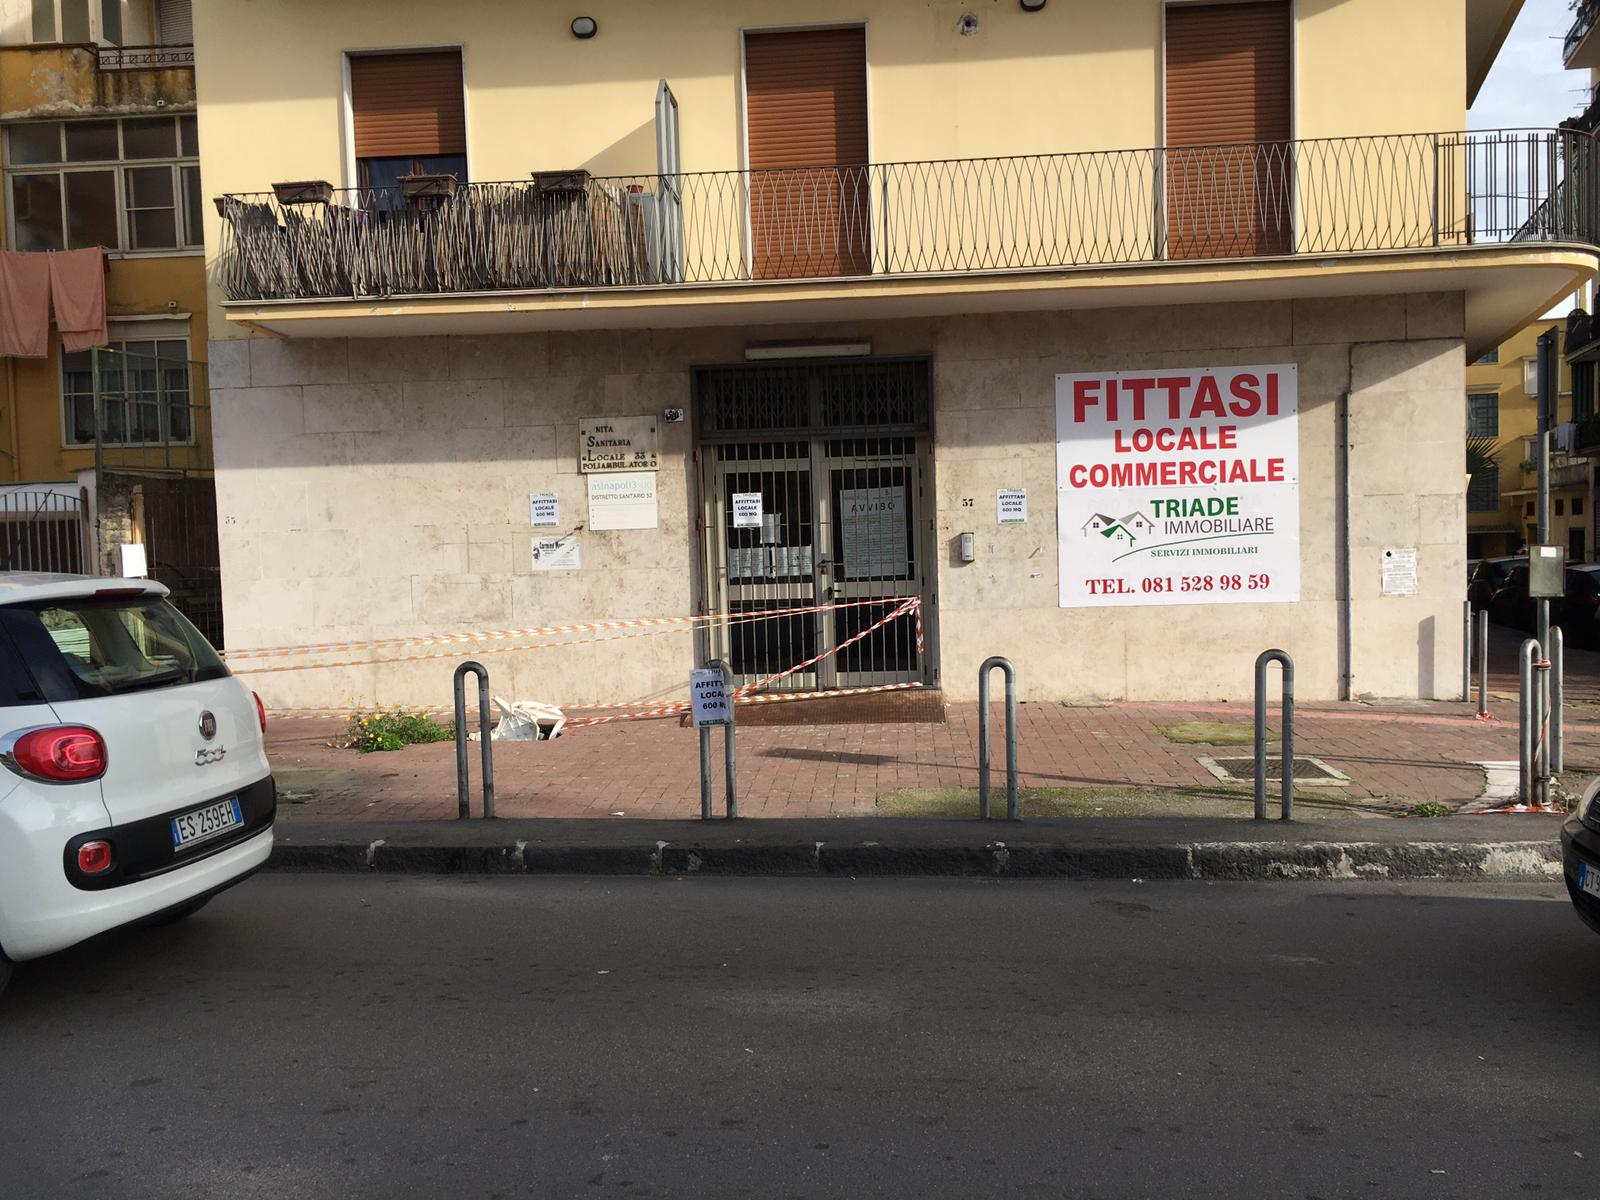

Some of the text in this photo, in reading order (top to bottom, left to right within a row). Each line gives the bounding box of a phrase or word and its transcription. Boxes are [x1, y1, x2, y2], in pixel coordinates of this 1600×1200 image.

[1073, 373, 1279, 423] FITTASI
[1114, 425, 1237, 453] LOCALE
[1069, 458, 1285, 488] COMMERCIALE
[851, 502, 895, 512] AVVISO
[1150, 497, 1239, 518] TRIADE
[1164, 517, 1274, 535] IMMOBILIARE
[1192, 546, 1259, 556] IMMOBILIARI
[1086, 574, 1271, 595] TEL. 081 528 98 59
[179, 801, 235, 840] ES 259EH
